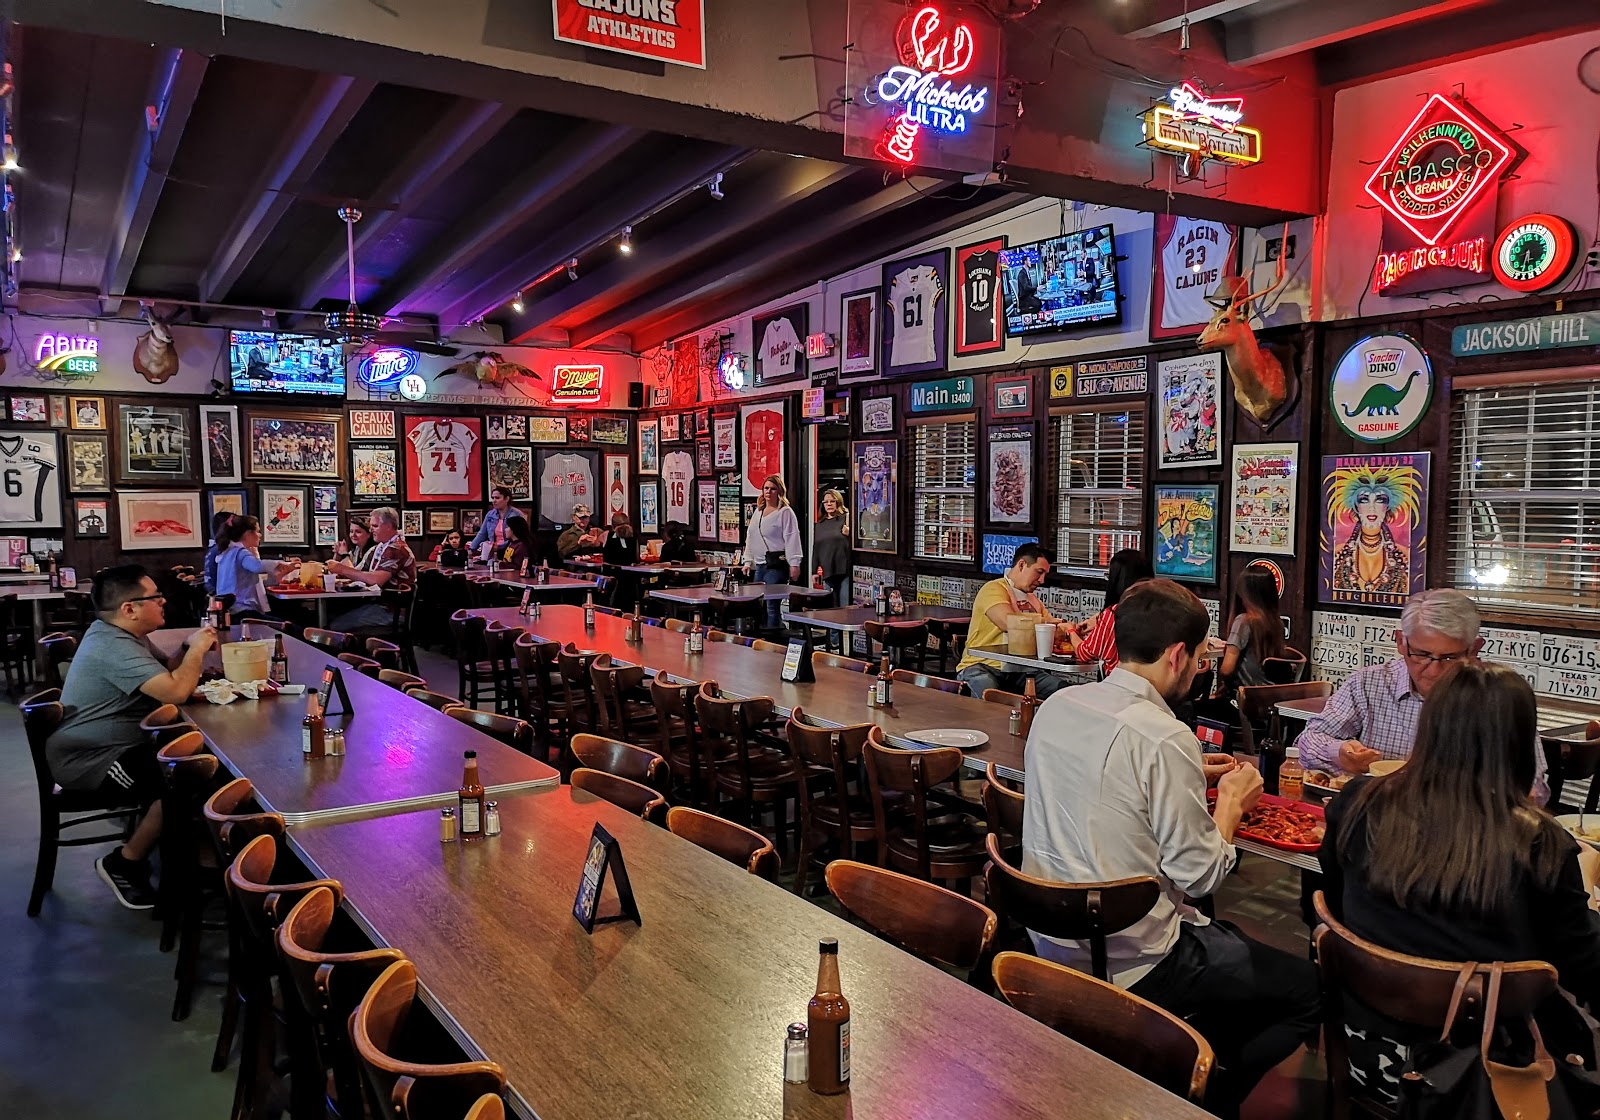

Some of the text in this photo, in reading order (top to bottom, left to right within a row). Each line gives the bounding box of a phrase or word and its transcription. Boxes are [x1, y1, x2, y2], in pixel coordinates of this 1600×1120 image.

[577, 0, 677, 26] AJUNS
[587, 15, 676, 49] ATHLETICS
[879, 66, 988, 113] Michelob
[906, 100, 965, 132] ULTRA
[1380, 149, 1493, 191] TABASCO
[1415, 178, 1454, 195] BRAND
[1396, 173, 1475, 216] PEPPER SAUCE
[1177, 226, 1219, 255] RAGIN
[1185, 246, 1206, 268] 23
[1371, 237, 1484, 293] RAGIN CAJUN
[968, 268, 992, 279] LOUISIANA
[1176, 268, 1218, 289] CAJUNS
[972, 280, 988, 303] 10
[903, 294, 923, 328] 61
[969, 302, 990, 311] Lafayette
[1461, 318, 1589, 352] JACKSON HILL
[36, 335, 98, 361] ABITA
[809, 335, 823, 355] EXIT
[780, 352, 791, 366] 27
[1368, 352, 1400, 363] Sinclair
[68, 359, 98, 372] BEER
[1089, 364, 1107, 373] NATIONAL
[1369, 362, 1397, 373] DINO
[560, 368, 599, 388] Miller
[1078, 374, 1146, 395] LSU AVENUE
[555, 387, 599, 396] Genuine Draft
[957, 380, 965, 391] ST
[654, 396, 669, 405] LIGHT
[914, 386, 971, 406] Main 13400
[355, 412, 390, 423] GEAUX
[532, 418, 550, 430] GO
[353, 424, 393, 436] CAJUNS
[1358, 422, 1399, 432] GASOLINE
[531, 431, 565, 441] COWBOYS
[431, 452, 457, 472] 74
[1336, 457, 1366, 467] MARDI
[1370, 456, 1397, 467] GRAS
[4, 468, 22, 497] 6
[567, 472, 585, 484] Miss
[573, 485, 586, 496] 16
[671, 482, 684, 507] 16
[88, 518, 99, 526] 72
[985, 542, 1017, 556] LOUISI
[987, 551, 1014, 565] SEAF
[1066, 596, 1079, 606] 029
[1333, 591, 1409, 604] NEW ORLEANS
[1327, 613, 1348, 621] TEXAS
[1494, 631, 1521, 640] TEXAS
[1326, 642, 1346, 650] TEXAS
[1542, 645, 1600, 669] 076-1S
[1324, 669, 1346, 677] TEXAS
[1560, 672, 1588, 681] TEXAS
